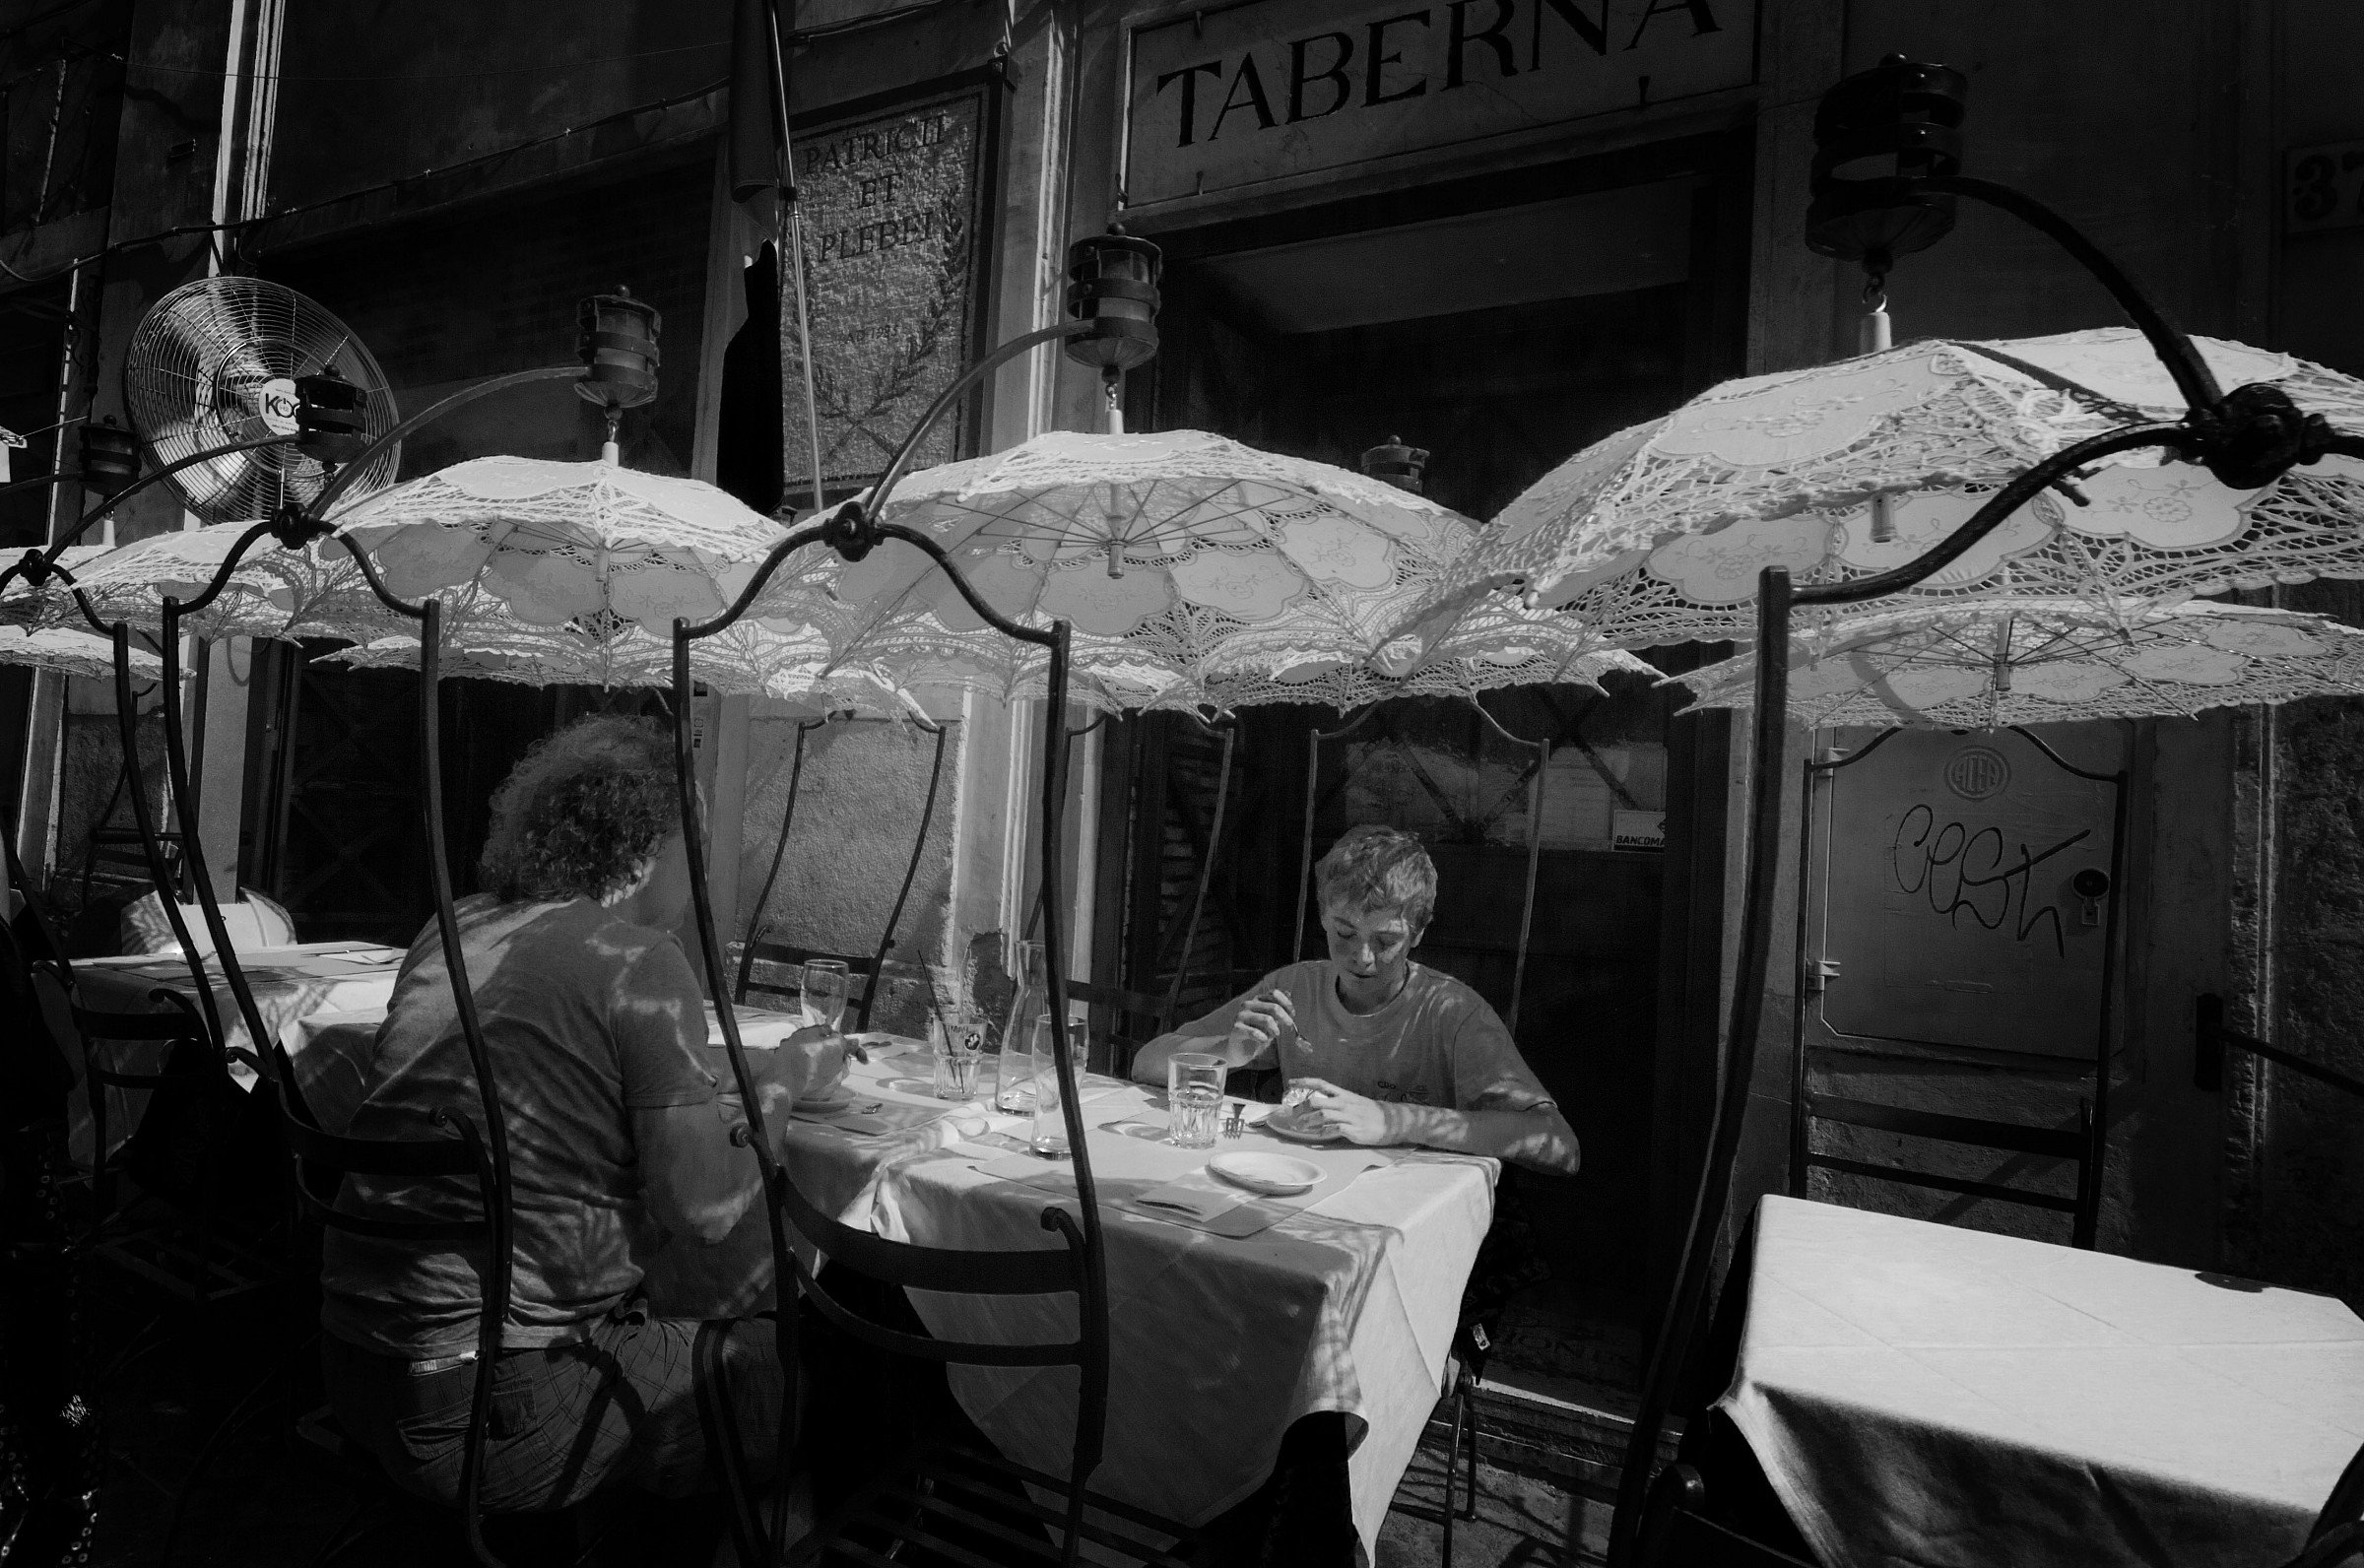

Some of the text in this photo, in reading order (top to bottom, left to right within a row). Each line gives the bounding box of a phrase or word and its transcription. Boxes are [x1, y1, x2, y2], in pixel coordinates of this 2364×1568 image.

[1156, 0, 1723, 148] TABERNA
[856, 171, 902, 210] ET
[819, 211, 934, 263] PLEBEI
